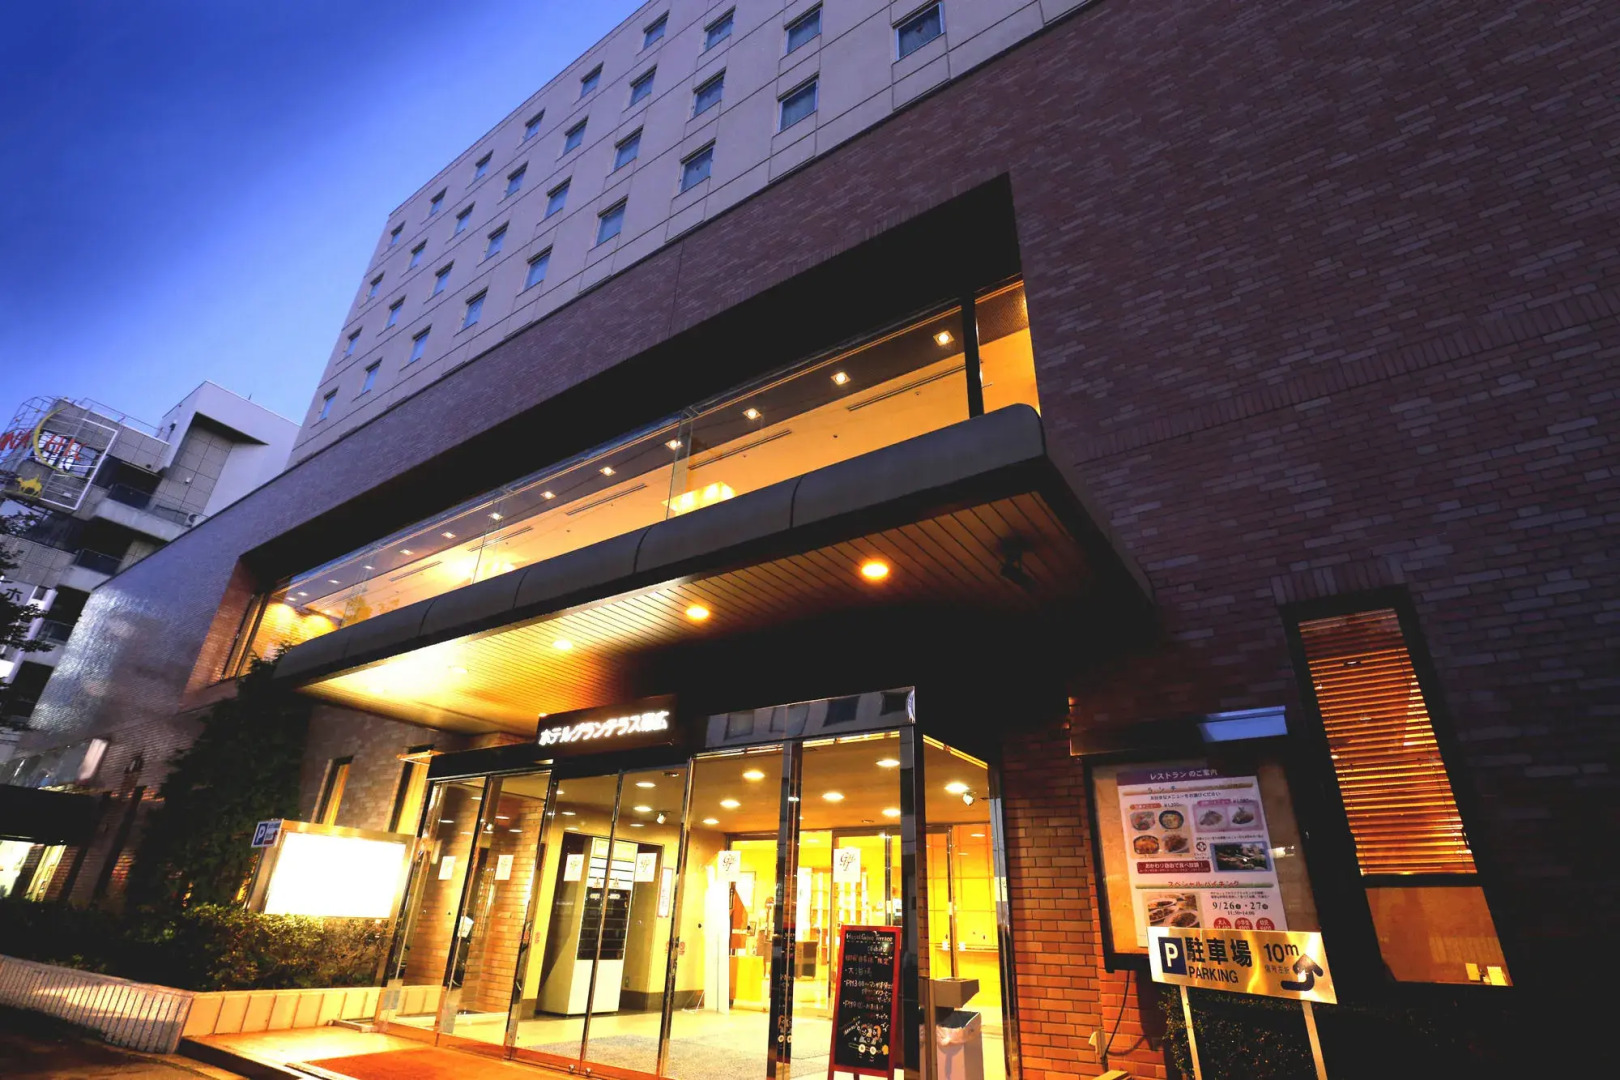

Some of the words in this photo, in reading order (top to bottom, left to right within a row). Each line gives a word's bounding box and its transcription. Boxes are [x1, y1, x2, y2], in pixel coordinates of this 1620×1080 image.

[1164, 942, 1178, 967] P
[1185, 937, 1253, 967] 駐車場
[1263, 943, 1299, 963] 10m
[1188, 966, 1238, 983] PARKING
